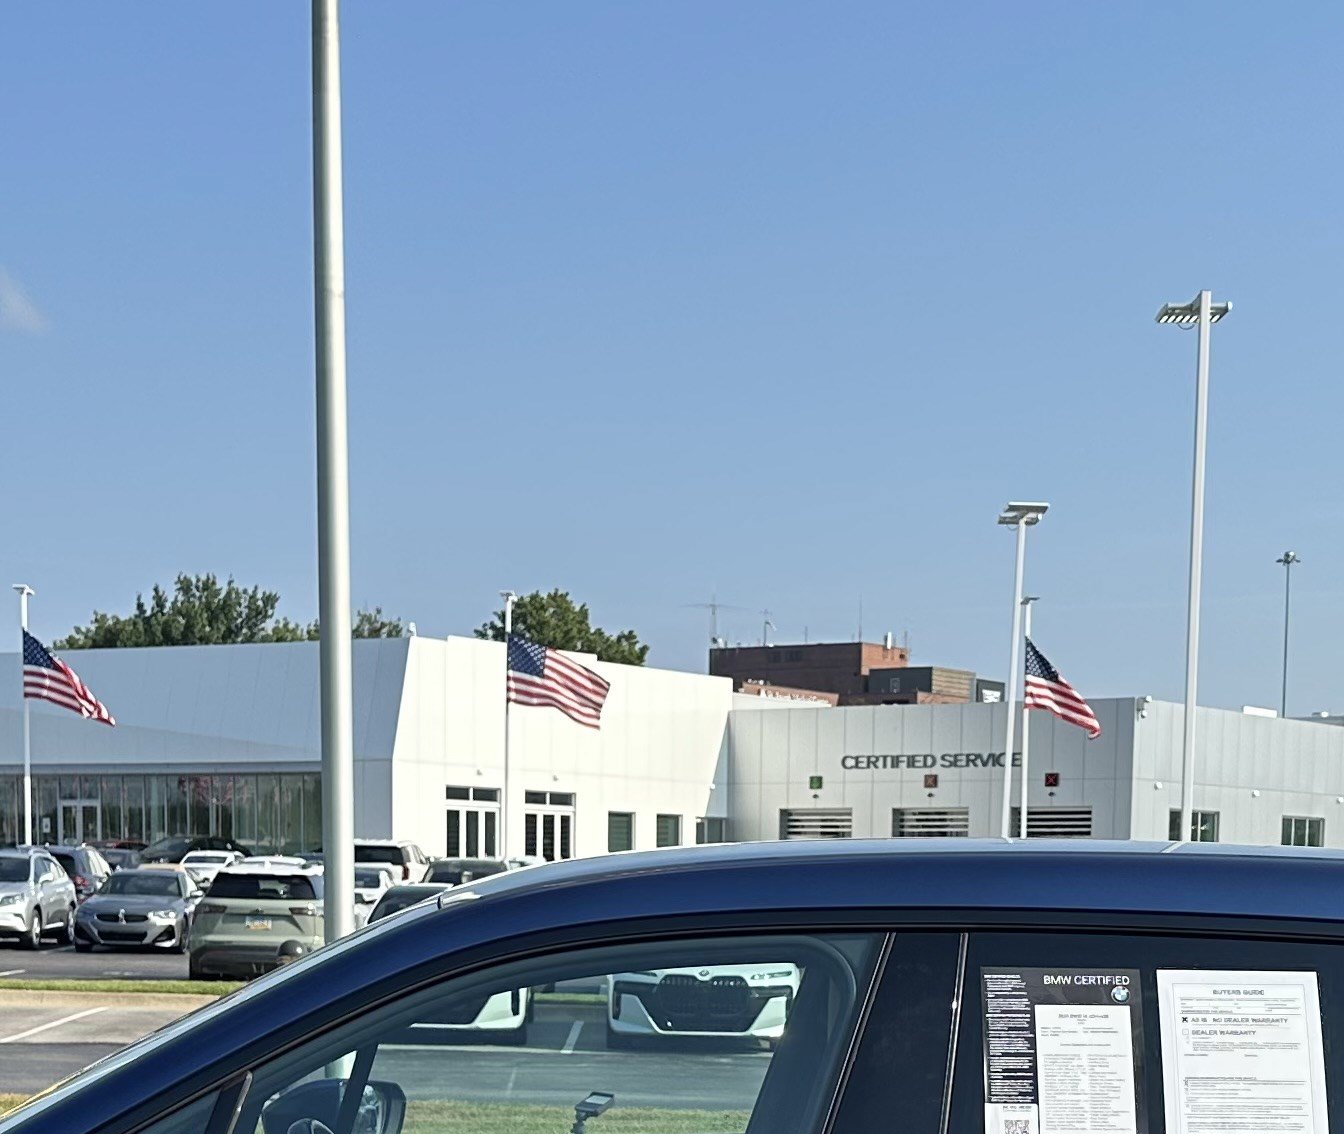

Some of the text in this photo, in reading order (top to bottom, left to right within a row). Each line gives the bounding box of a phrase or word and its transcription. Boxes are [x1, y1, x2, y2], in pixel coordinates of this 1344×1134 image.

[841, 752, 1022, 769] CERTIFIED SERVICE
[1043, 974, 1130, 985] BMW CERTIFIED
